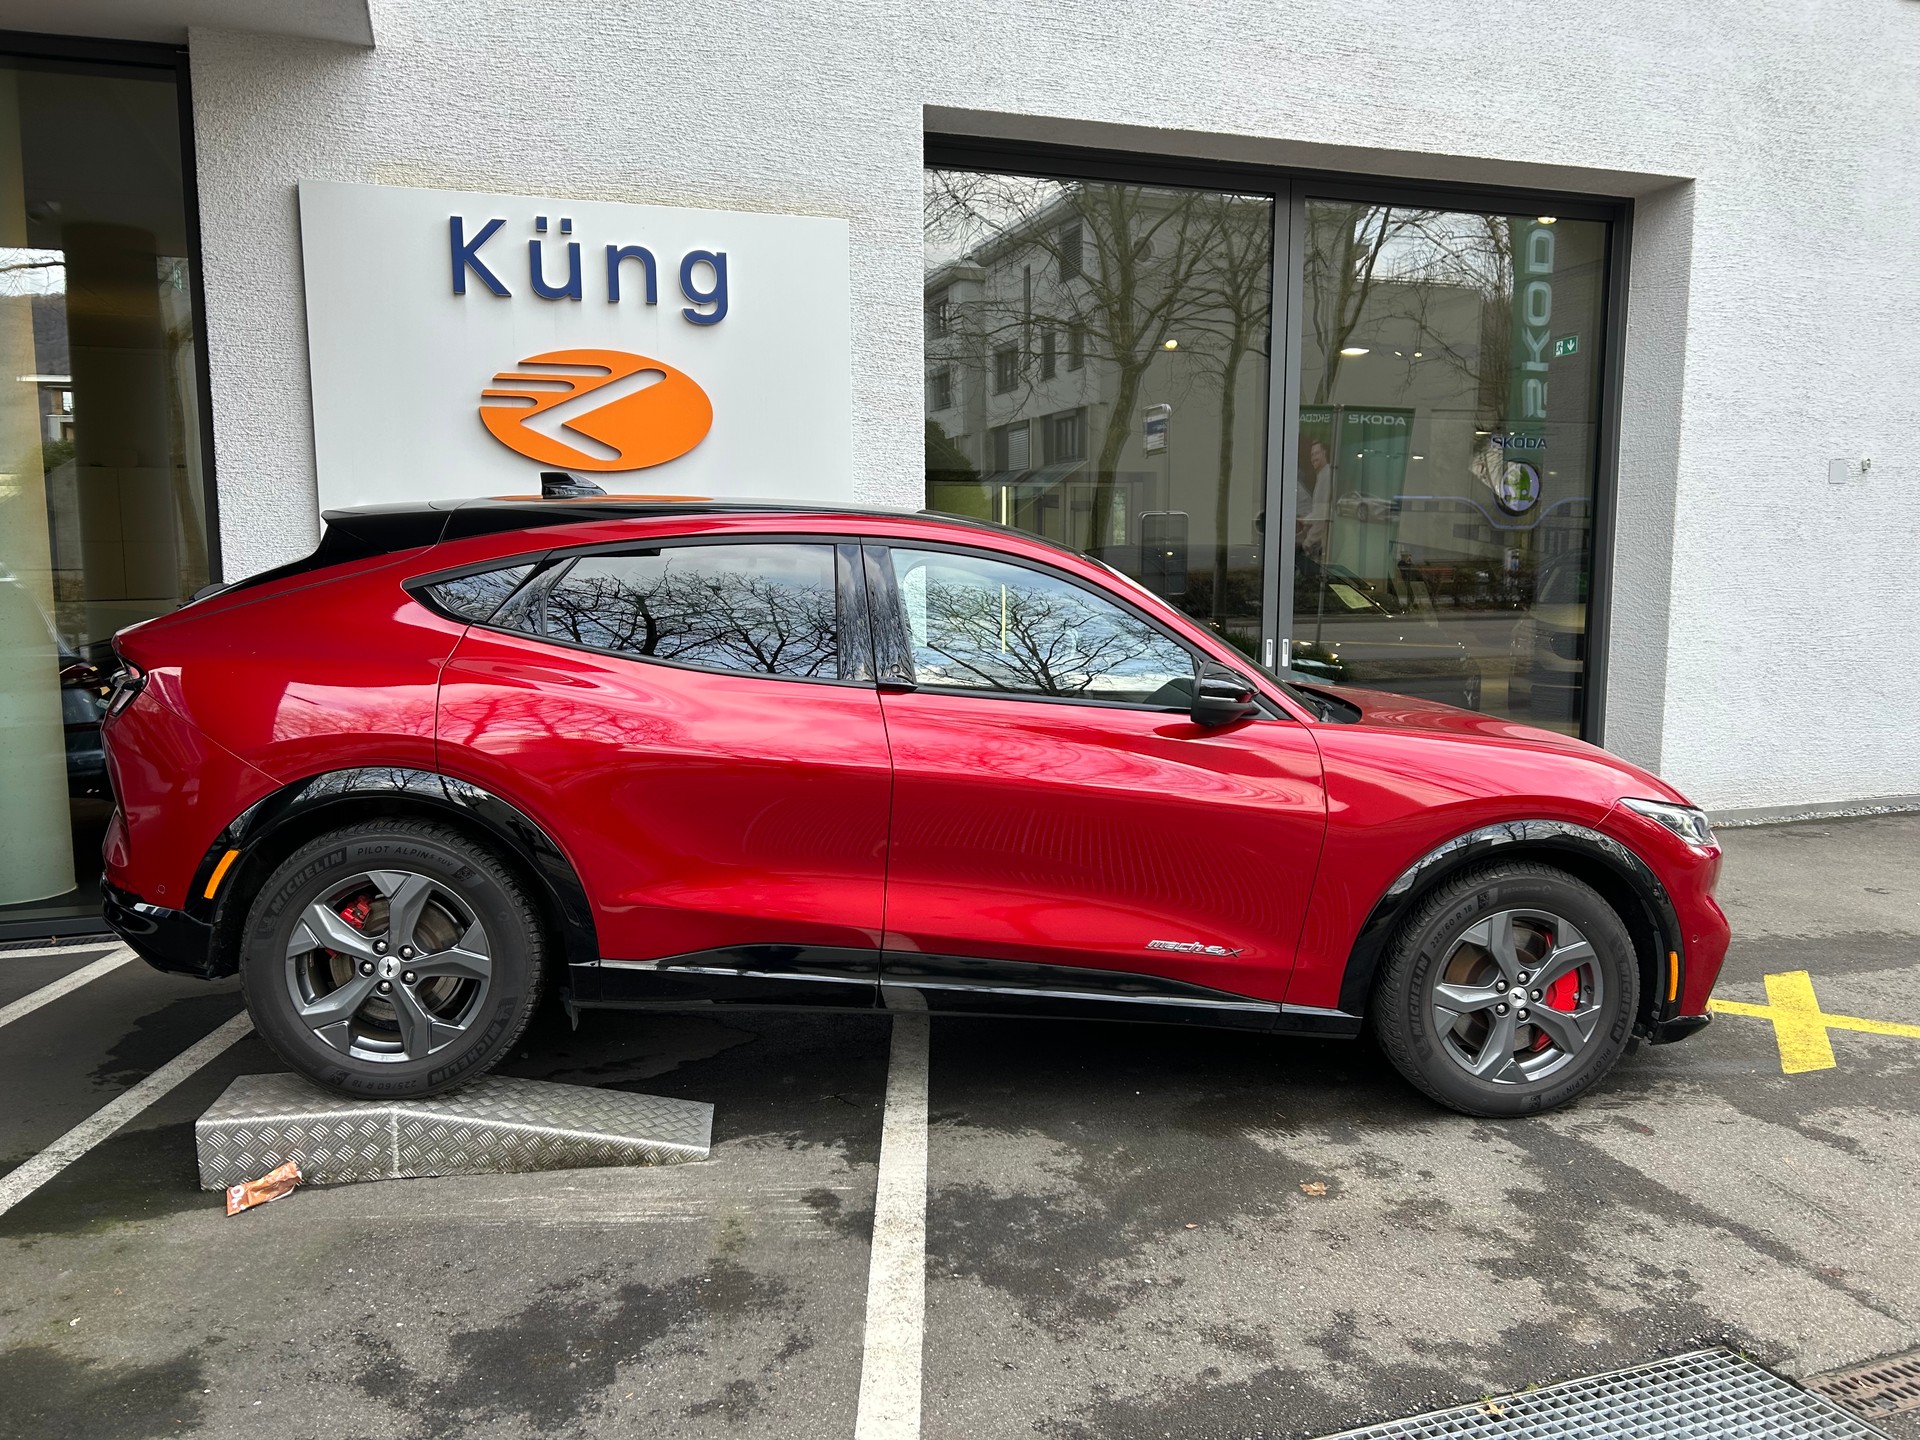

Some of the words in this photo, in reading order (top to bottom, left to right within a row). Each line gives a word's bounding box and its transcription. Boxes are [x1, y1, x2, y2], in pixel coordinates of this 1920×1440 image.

[449, 215, 729, 326] Küng
[357, 845, 390, 856] PILOT
[269, 851, 344, 914] MICHELIN
[1430, 918, 1455, 948] 225/60
[1455, 912, 1462, 920] R
[1409, 955, 1429, 1037] MICHELIN
[1613, 961, 1632, 1041] MICHELIN
[377, 1080, 417, 1090] 225/60
[430, 1022, 503, 1087] MICHELIN
[1592, 1047, 1612, 1073] PILOT
